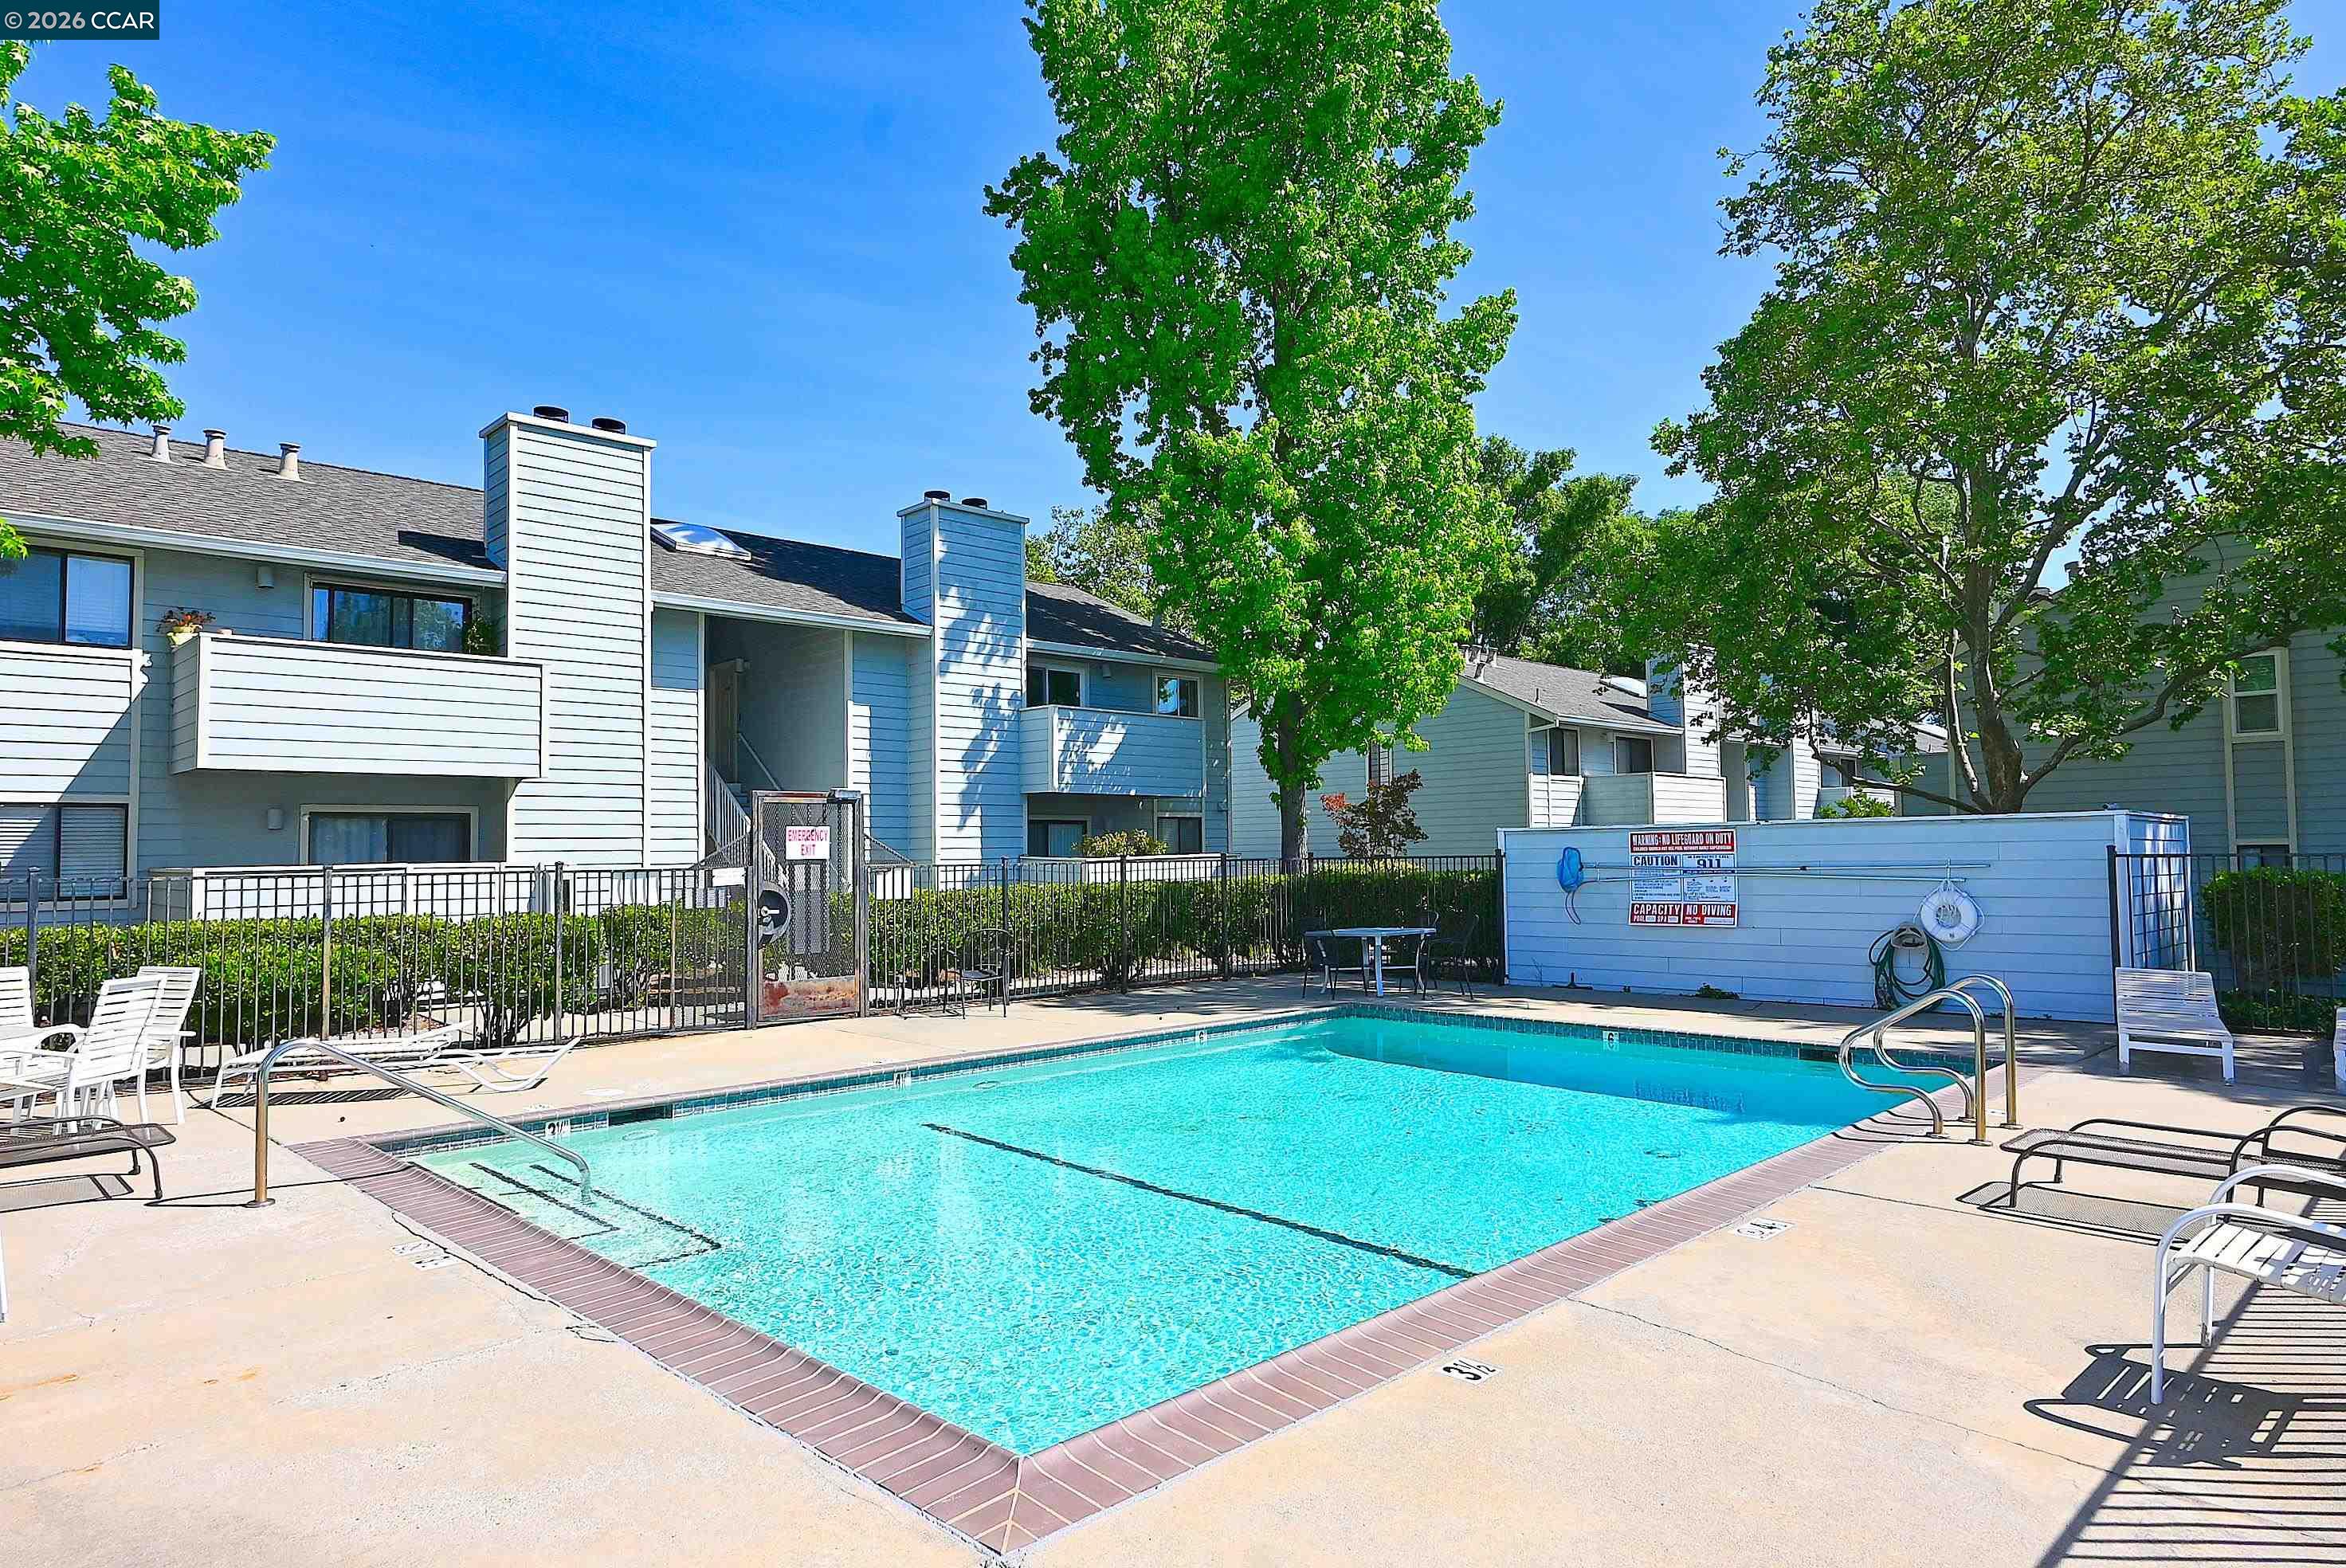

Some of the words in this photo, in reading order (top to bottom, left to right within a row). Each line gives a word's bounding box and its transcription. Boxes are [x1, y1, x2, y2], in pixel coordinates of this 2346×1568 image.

[787, 828, 830, 842] EMERGENCY
[1662, 833, 1670, 845] NO
[1671, 833, 1704, 845] LIFEGUARD
[1705, 832, 1714, 845] ON
[1716, 832, 1732, 845] DUTY
[801, 843, 816, 856] EXIT
[1634, 856, 1678, 866] CAUTION
[1697, 859, 1721, 868] 911
[1633, 904, 1681, 915] CAPACITY
[1685, 904, 1698, 915] NO
[1701, 904, 1732, 916] DIVING
